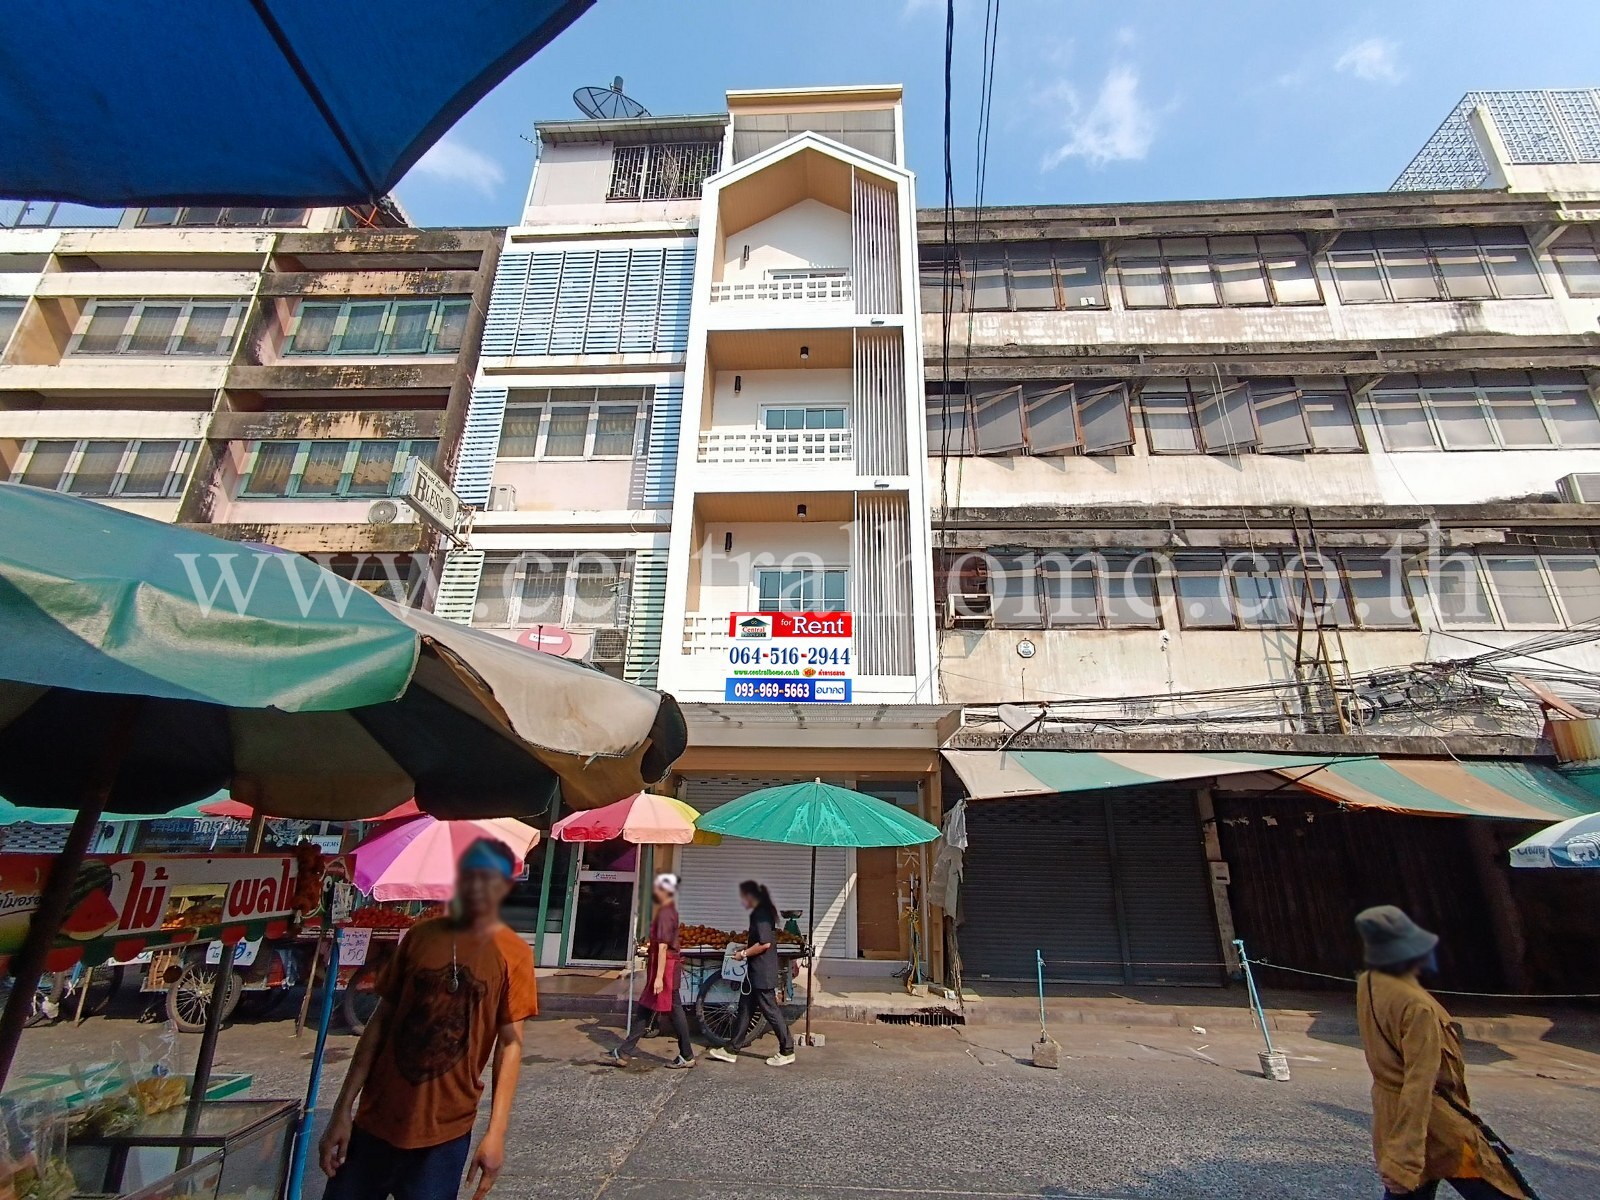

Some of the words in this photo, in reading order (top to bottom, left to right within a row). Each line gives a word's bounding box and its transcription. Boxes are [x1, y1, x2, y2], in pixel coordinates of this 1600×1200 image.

[413, 471, 445, 514] BLESS
[781, 618, 792, 626] for
[792, 616, 844, 634] Rent
[729, 647, 850, 665] 064-516-2944
[734, 682, 810, 698] 093-969-5663
[816, 687, 845, 695] อนาคต
[118, 861, 169, 931] ไม้
